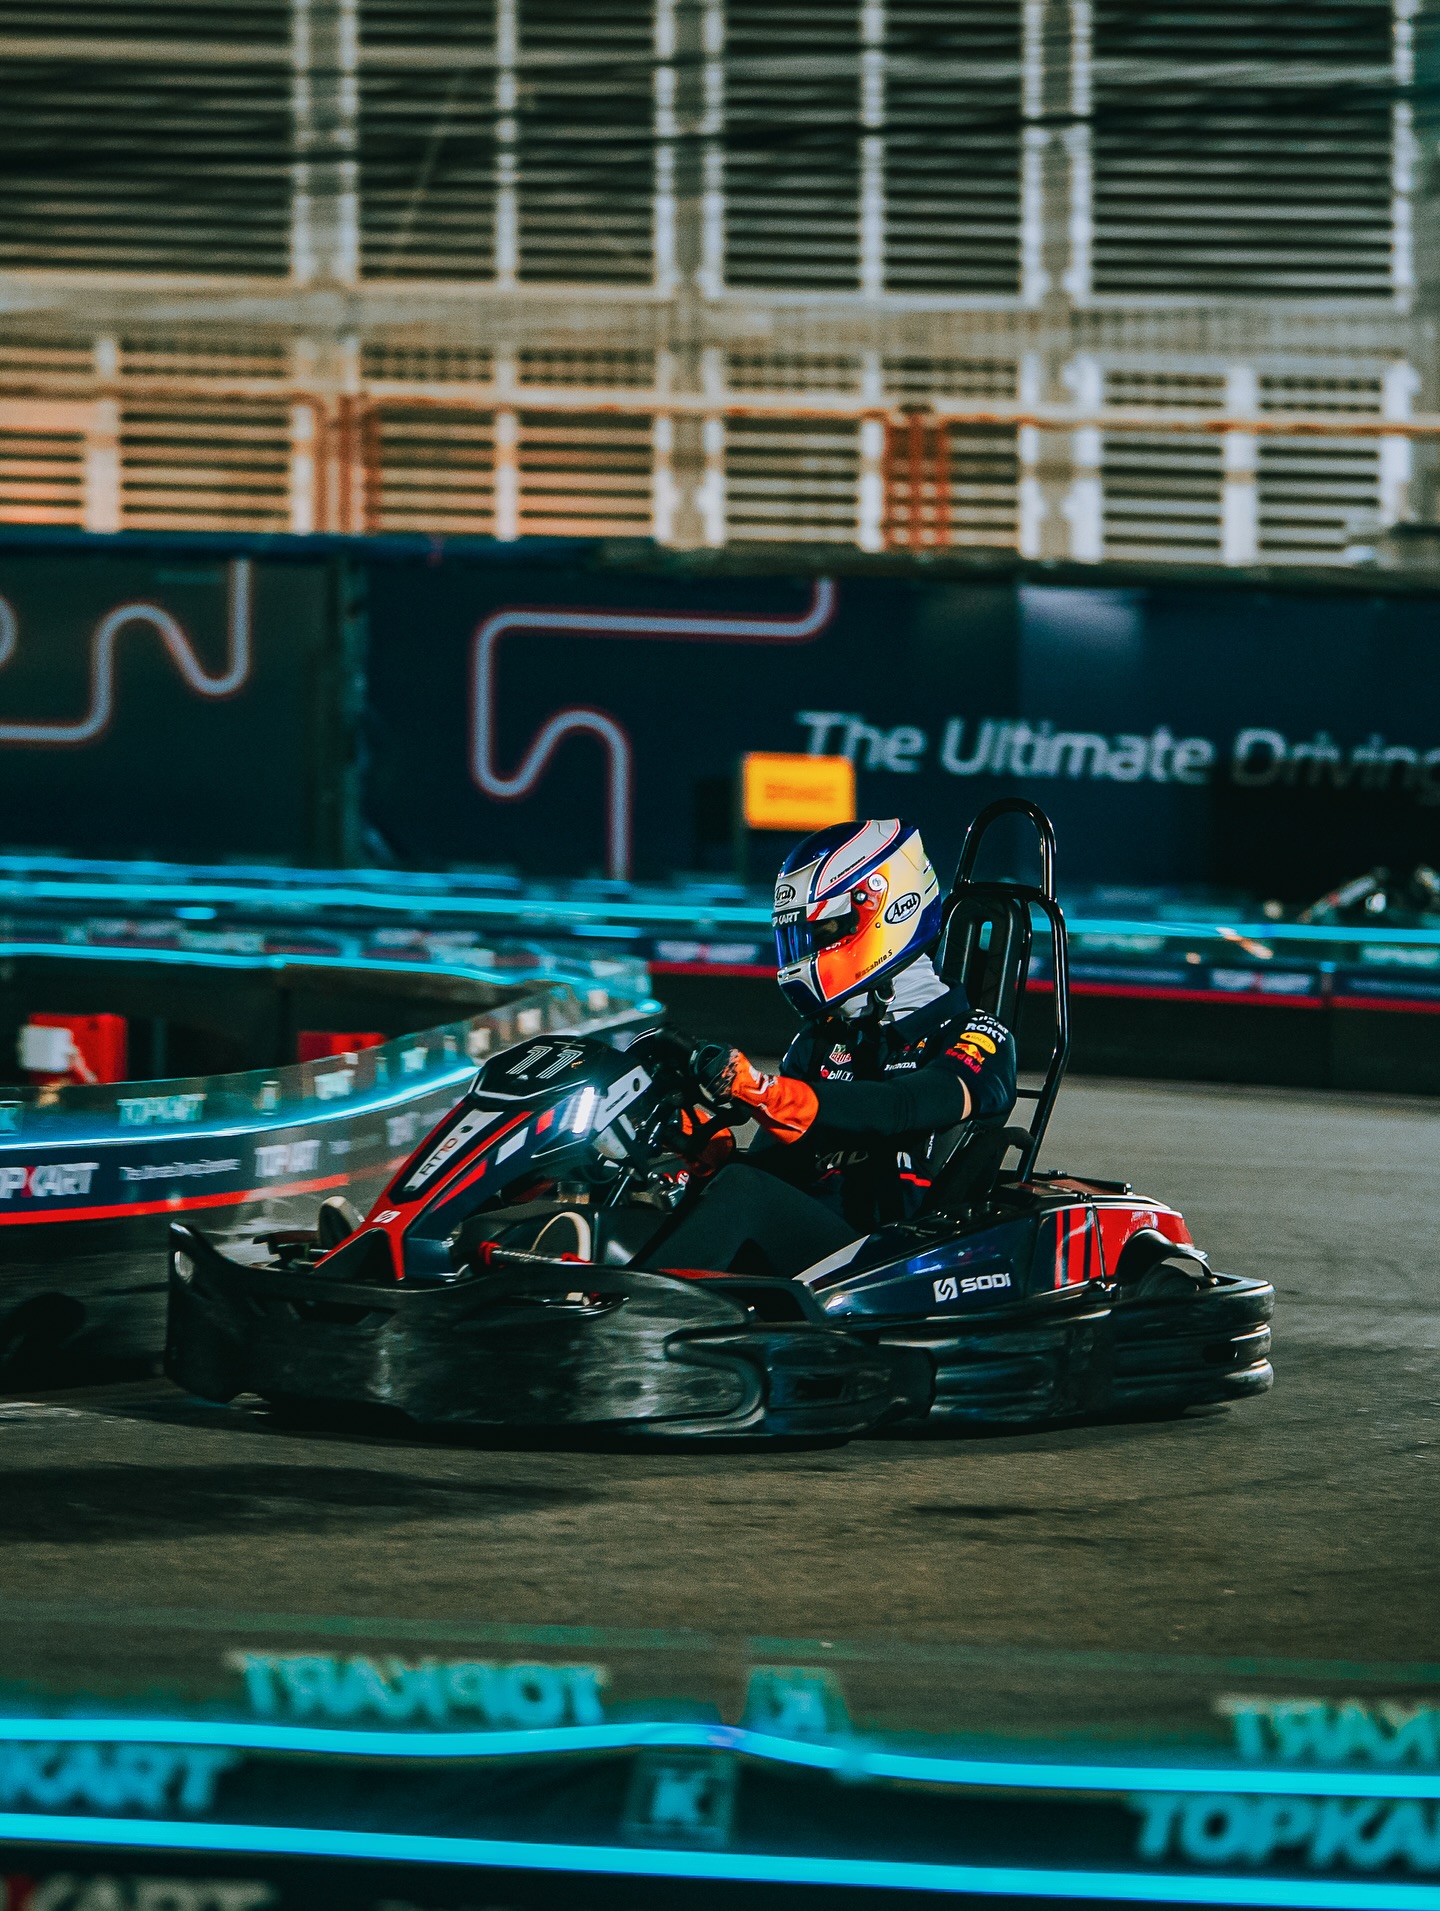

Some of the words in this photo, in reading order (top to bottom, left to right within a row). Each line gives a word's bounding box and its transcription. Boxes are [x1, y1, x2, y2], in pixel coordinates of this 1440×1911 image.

[796, 710, 926, 773] The
[941, 717, 1214, 784] Ultimate
[890, 894, 917, 921] Arai
[965, 1022, 1006, 1043] ROKT
[506, 1045, 584, 1080] 11
[884, 1061, 917, 1071] HONDA
[945, 1048, 966, 1061] Red
[963, 1056, 982, 1074] Bull
[960, 1273, 1011, 1293] SODI
